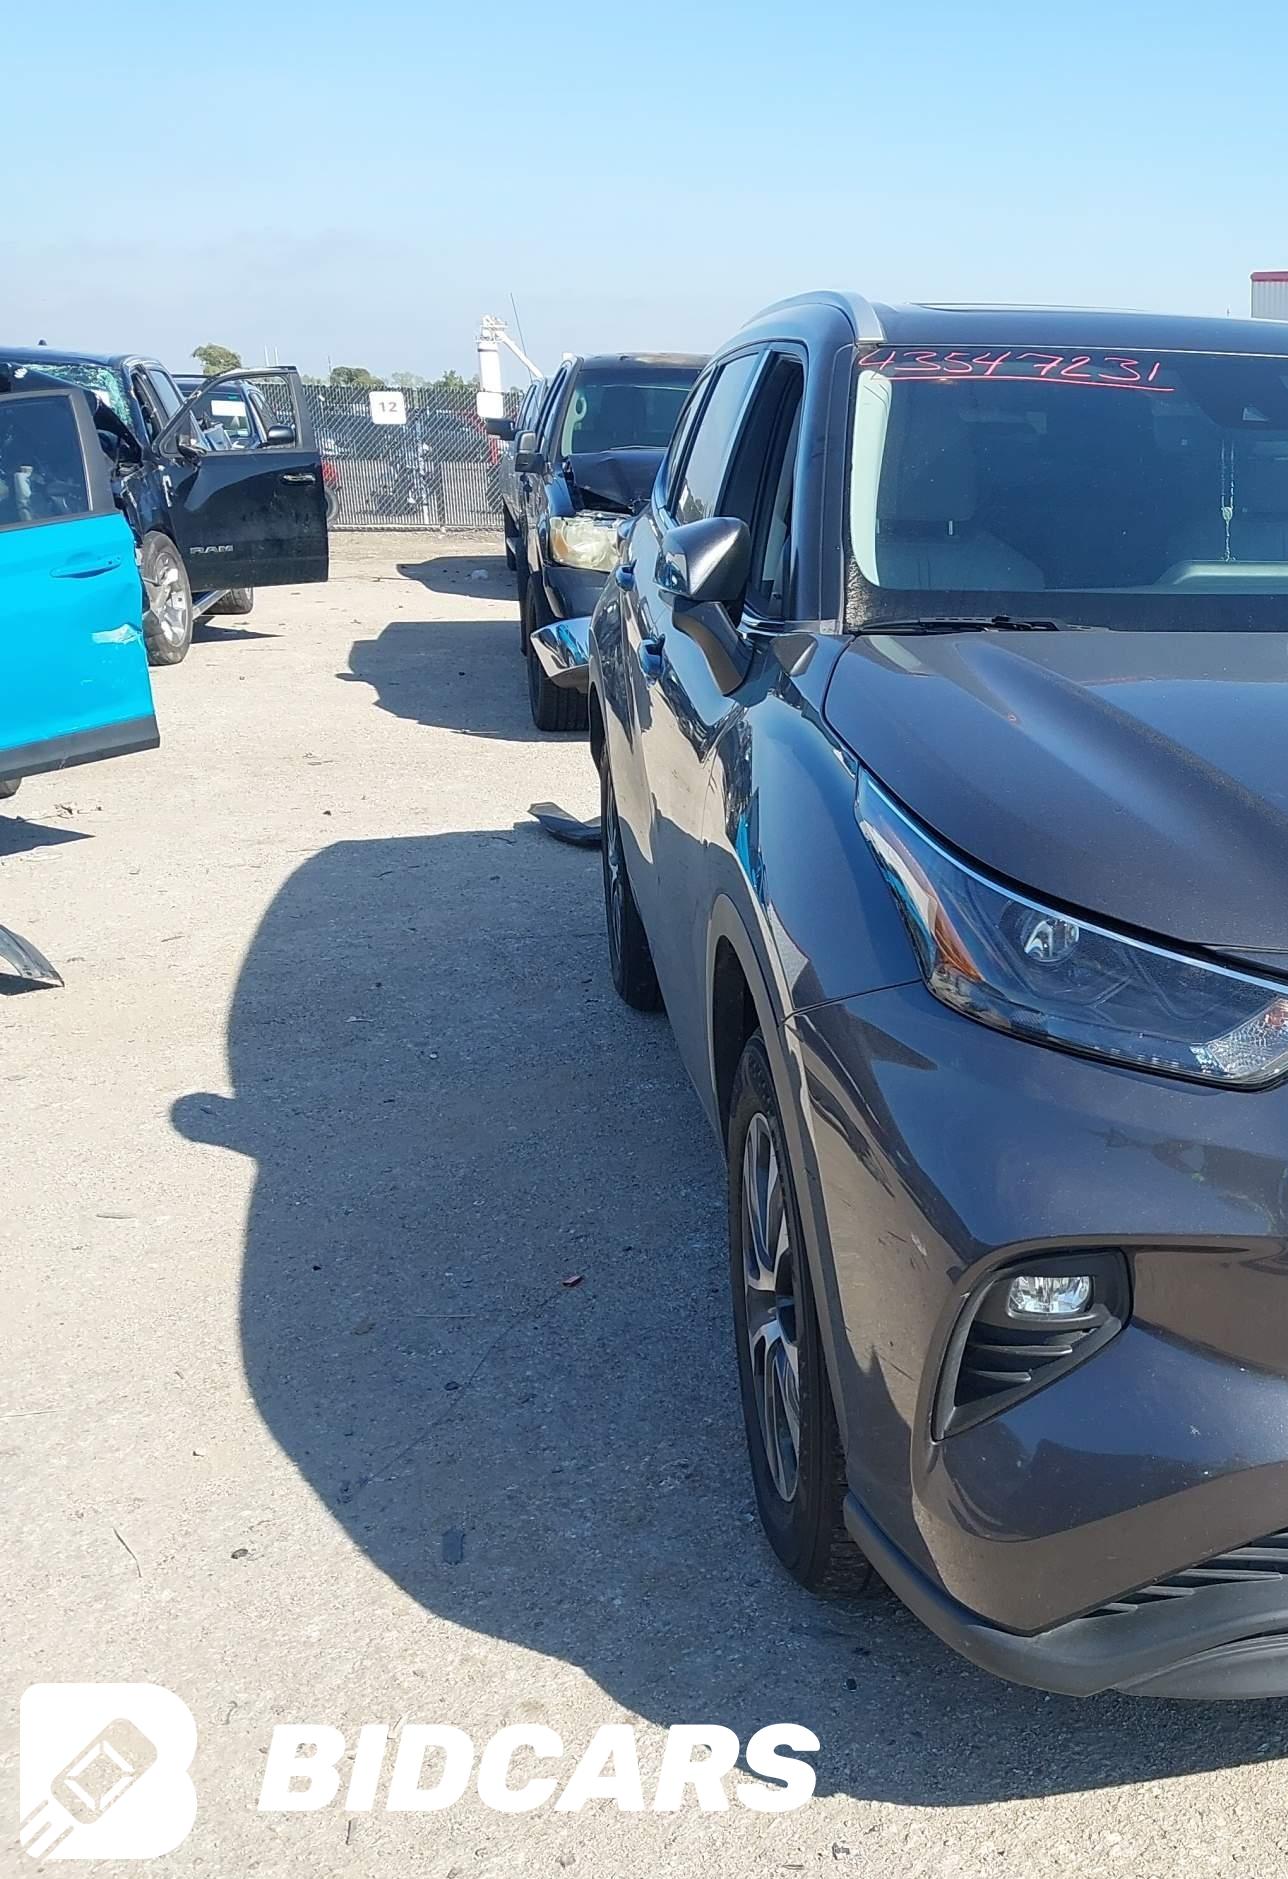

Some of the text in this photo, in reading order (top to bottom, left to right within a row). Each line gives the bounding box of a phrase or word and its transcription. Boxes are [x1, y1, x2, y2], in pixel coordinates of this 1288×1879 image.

[858, 350, 1160, 381] 43547231
[379, 401, 398, 412] 12
[190, 545, 234, 554] RAM
